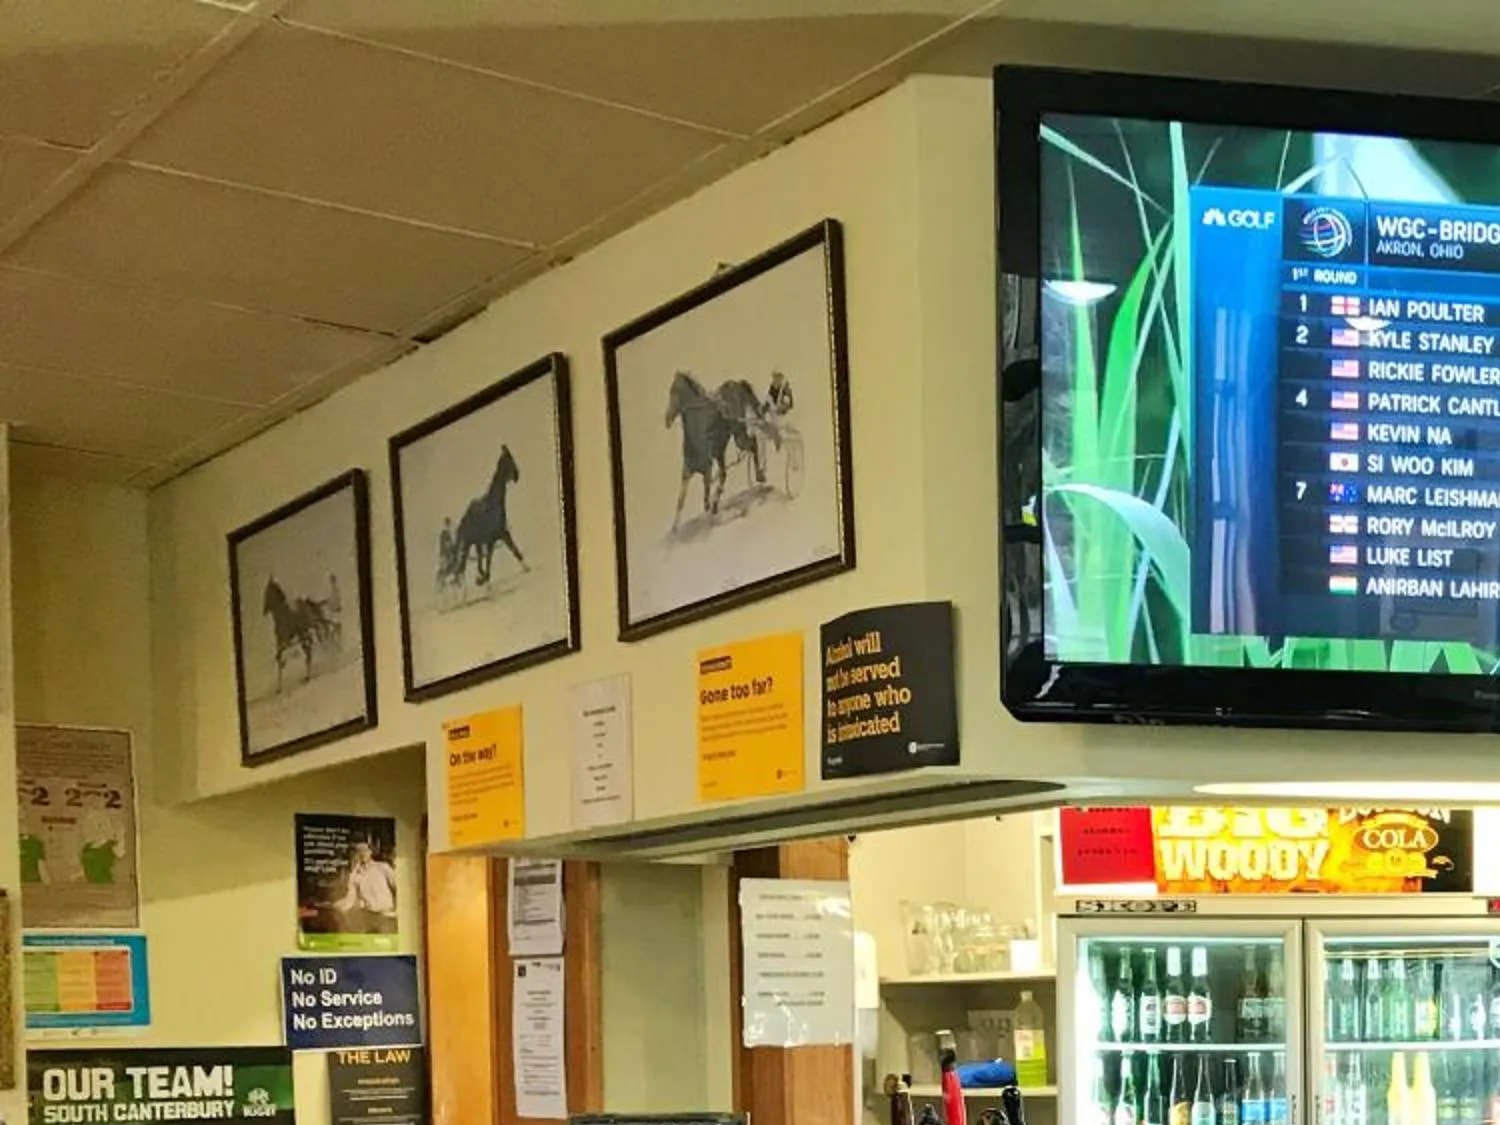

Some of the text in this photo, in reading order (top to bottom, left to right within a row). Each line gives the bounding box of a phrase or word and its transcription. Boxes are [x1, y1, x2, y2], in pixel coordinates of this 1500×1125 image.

[1228, 209, 1276, 230] GOLF
[1376, 239, 1463, 260] AKRON, OHIO
[1314, 269, 1357, 285] ROUND
[1297, 296, 1307, 312] 1
[1369, 299, 1399, 318] IAN
[1407, 302, 1484, 323] POULTER
[1295, 326, 1308, 345] 2
[1369, 330, 1411, 351] KYLE
[1418, 333, 1494, 355] STANLEY
[1369, 361, 1425, 382] RICKIE
[1431, 365, 1500, 386] FOWLER
[1295, 389, 1308, 407] 4
[1367, 392, 1440, 415] PATRICK
[1367, 423, 1421, 444] KEVIN
[1427, 426, 1452, 446] NA
[1367, 454, 1385, 473] SI
[1393, 456, 1434, 475] WOO
[1441, 458, 1473, 478] KIM
[1296, 483, 1307, 500] 7
[1367, 485, 1418, 506] MARC
[1367, 517, 1414, 537] RORY
[1421, 519, 1496, 539] McILROY
[1367, 547, 1411, 567] LUKE
[1417, 549, 1453, 568] LIST
[1366, 577, 1443, 597] ANIRBAN
[854, 631, 881, 655] will
[851, 656, 901, 684] served
[700, 675, 773, 705] Gone too far?
[874, 683, 912, 707] who
[1158, 806, 1330, 838] BIG
[1362, 828, 1428, 849] COLA
[1158, 841, 1331, 881] WOODY
[290, 968, 337, 984] No ID
[291, 990, 382, 1007] No Service
[293, 1010, 414, 1031] No Exceptions
[336, 1049, 411, 1065] THE LAW
[43, 1065, 235, 1101] OUR TEAM!
[43, 1100, 235, 1124] SOUTH CANTERBURY
